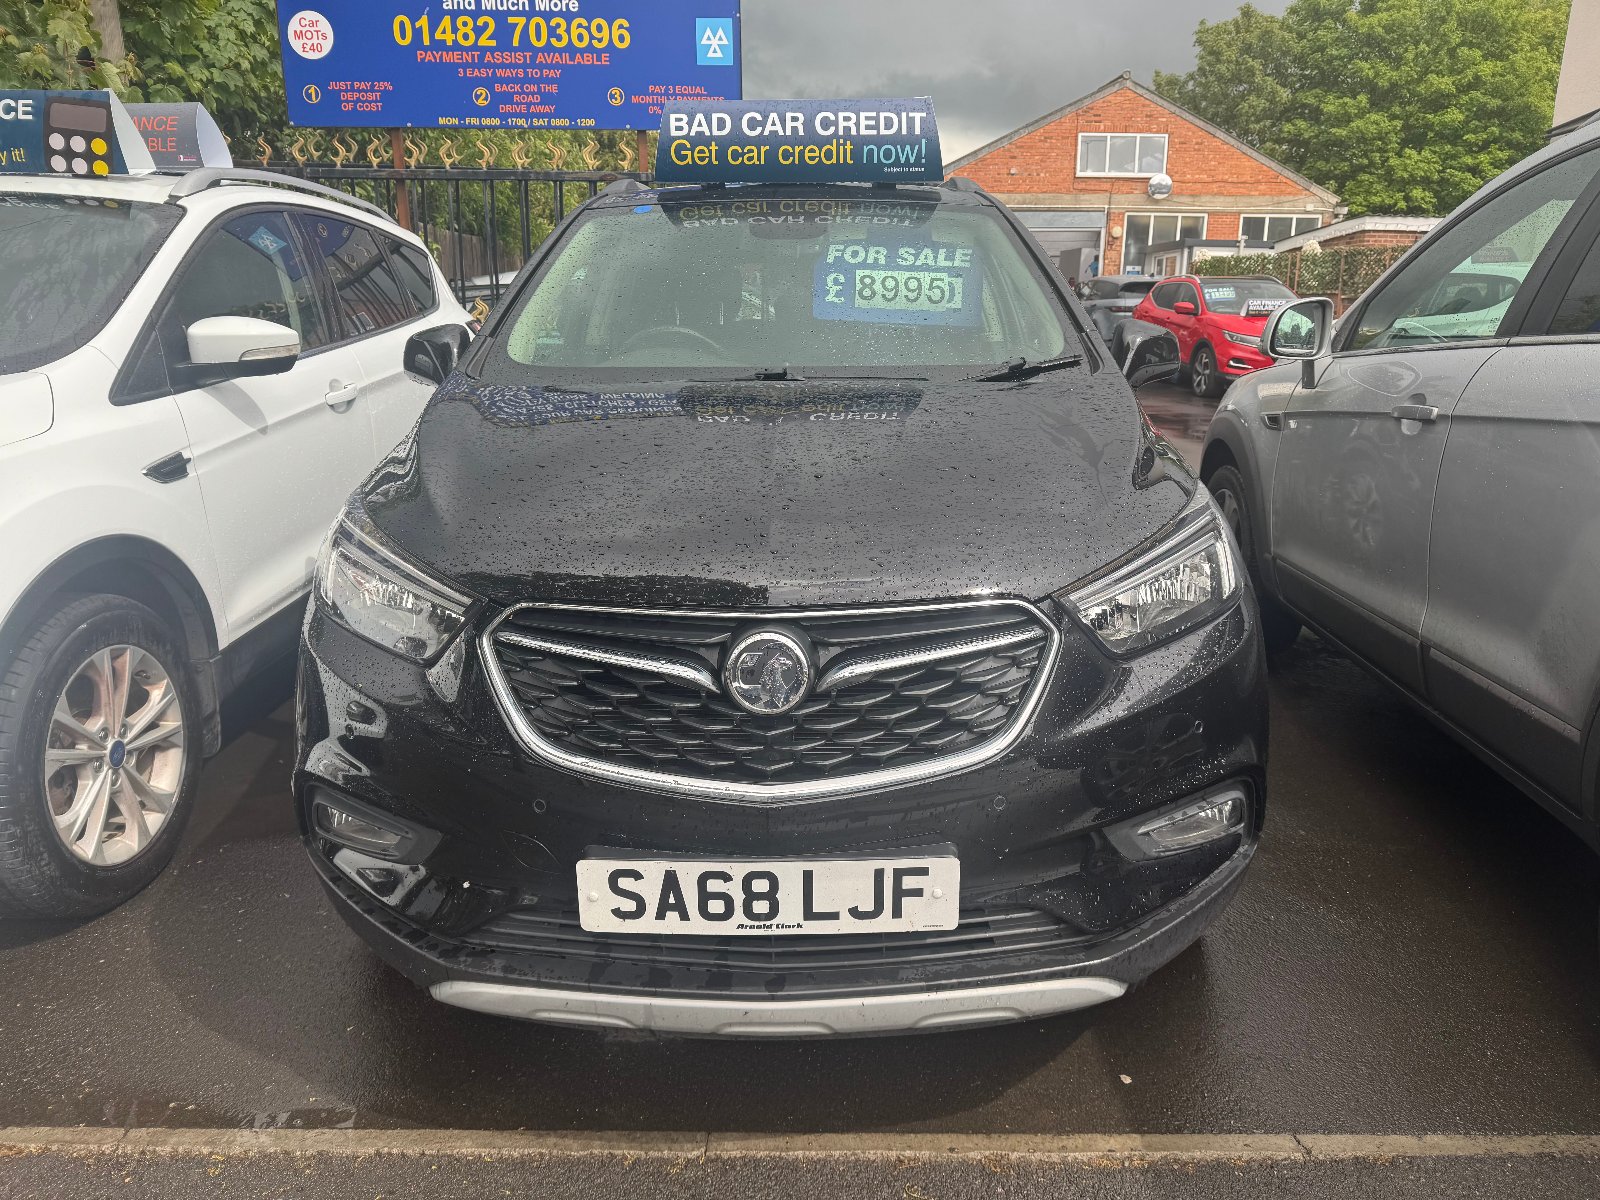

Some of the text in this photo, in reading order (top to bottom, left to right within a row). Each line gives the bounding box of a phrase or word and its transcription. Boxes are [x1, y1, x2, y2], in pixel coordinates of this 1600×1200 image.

[442, 0, 579, 12] and Much More
[298, 17, 320, 28] Car
[293, 29, 328, 41] MOTs
[393, 15, 631, 49] 01482 703696
[301, 42, 323, 53] £40
[417, 51, 610, 65] PAYMENT ASSIST AVAILABLE
[458, 68, 562, 78] 3 EASY WAYS TO PAY
[328, 81, 393, 91] JUST PAY 25%
[495, 84, 559, 93] BACK ON THE
[649, 85, 708, 95] PAY 3 EQUAL
[340, 92, 382, 101] DEPOSIT
[513, 94, 541, 103] ROAD
[611, 89, 622, 104] 3
[341, 103, 382, 111] OF COST
[499, 104, 556, 113] DRIVE AWAY
[438, 117, 459, 125] MON
[466, 117, 480, 126] FRI
[481, 118, 501, 126] 0800
[532, 118, 549, 126] SAT
[550, 118, 570, 127] 0800
[577, 118, 596, 127] 1200
[669, 111, 926, 137] BAD CAR CREDIT
[670, 138, 927, 166] Get car credit now!
[826, 244, 973, 268] FOR SALE
[607, 867, 930, 922] SA68 LJF
